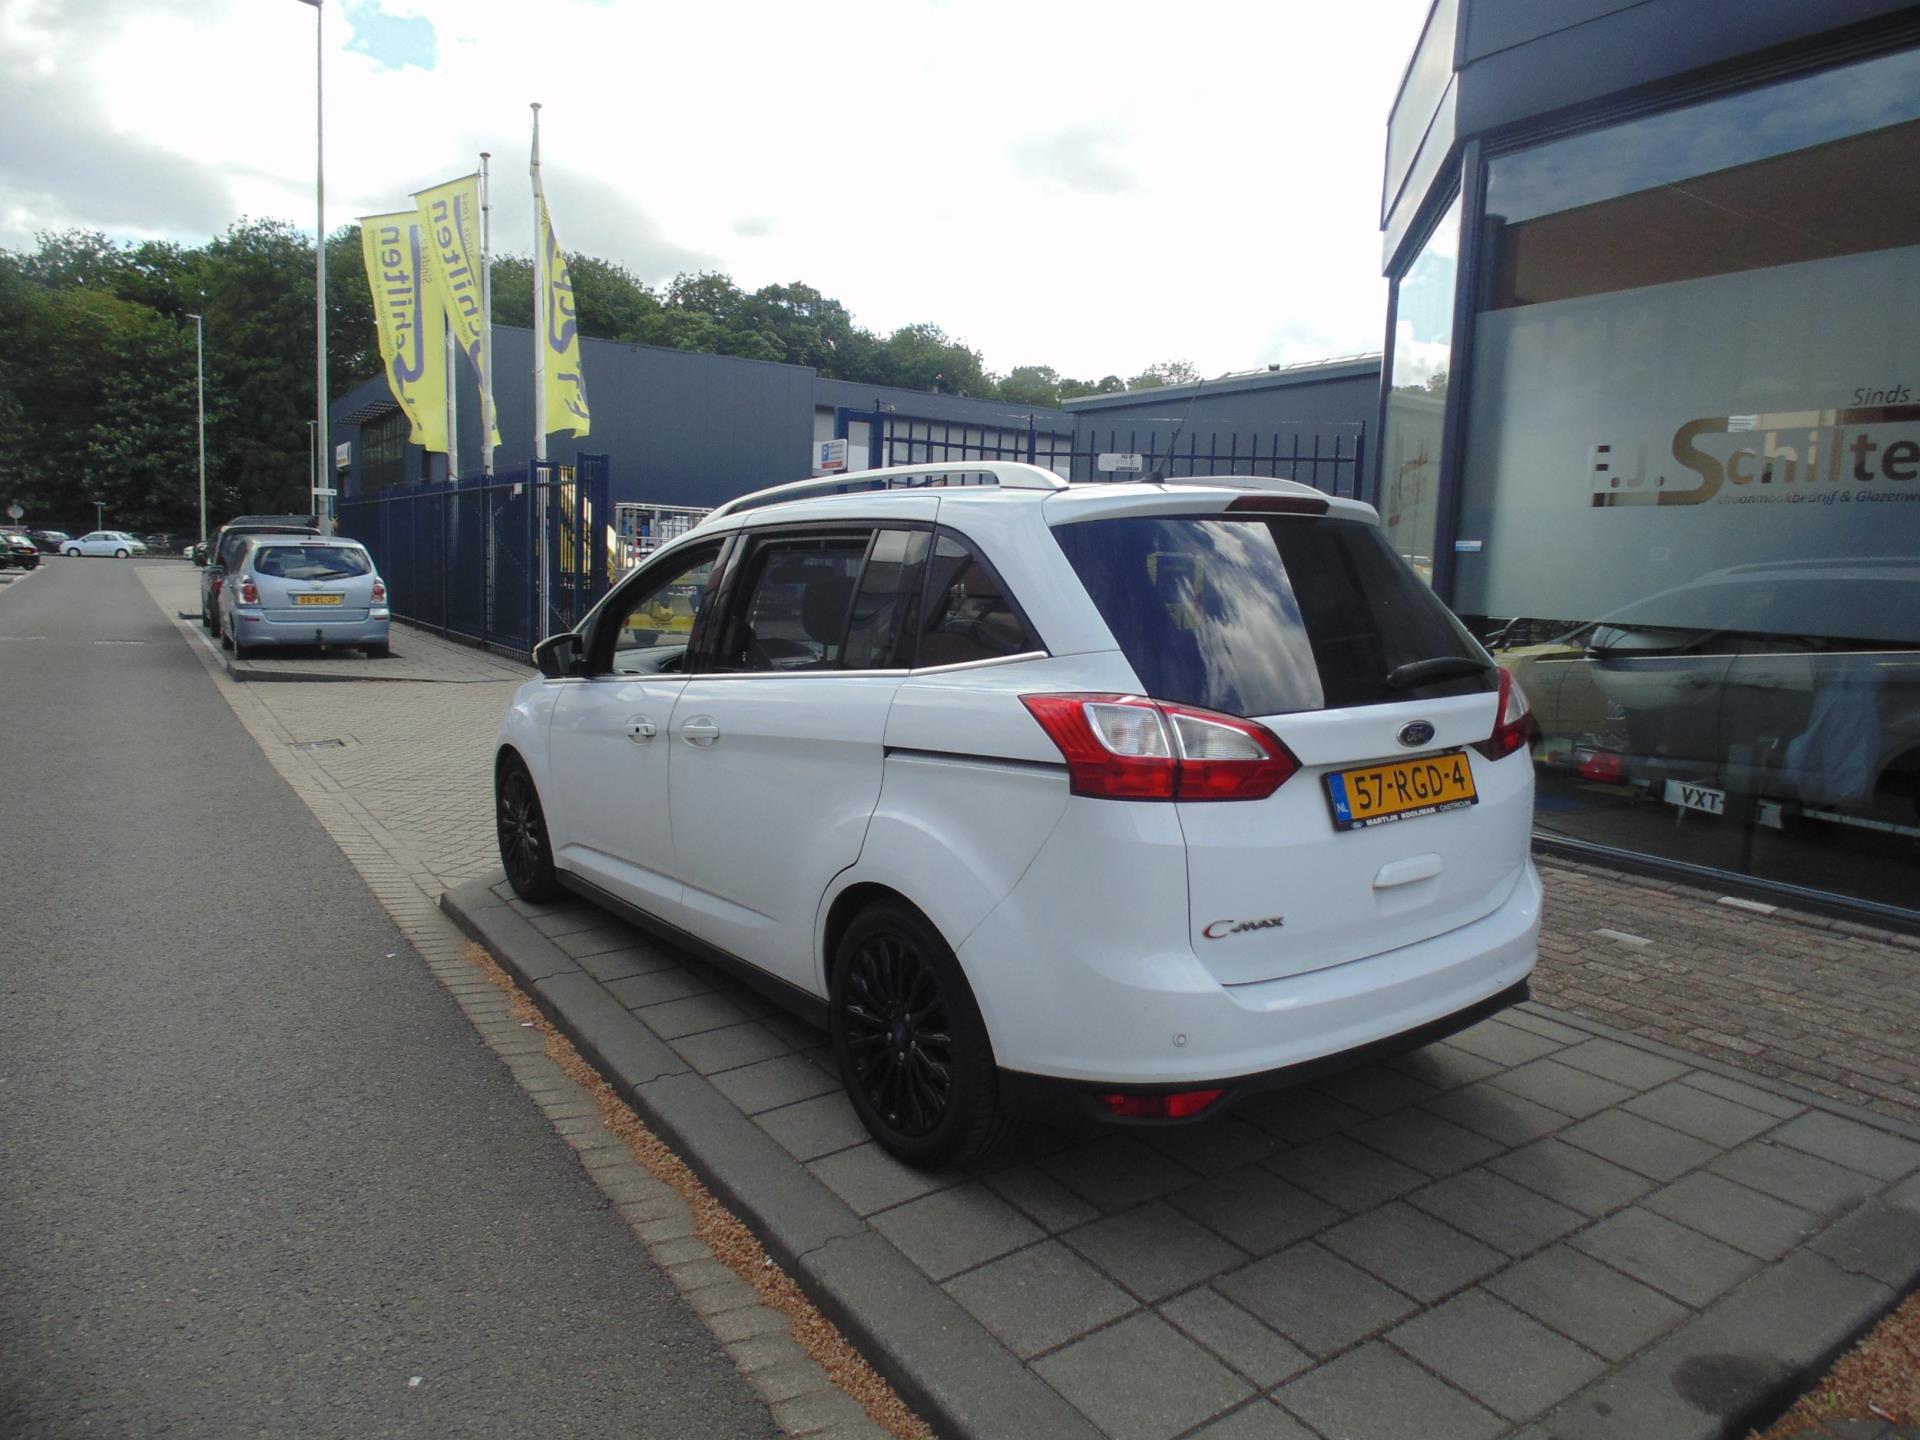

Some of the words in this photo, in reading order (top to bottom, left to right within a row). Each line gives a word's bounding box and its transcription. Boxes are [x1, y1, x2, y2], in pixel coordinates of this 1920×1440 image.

[1850, 384, 1912, 406] Sinds
[1354, 760, 1465, 810] 57-RGD-4
[1336, 802, 1349, 814] NL
